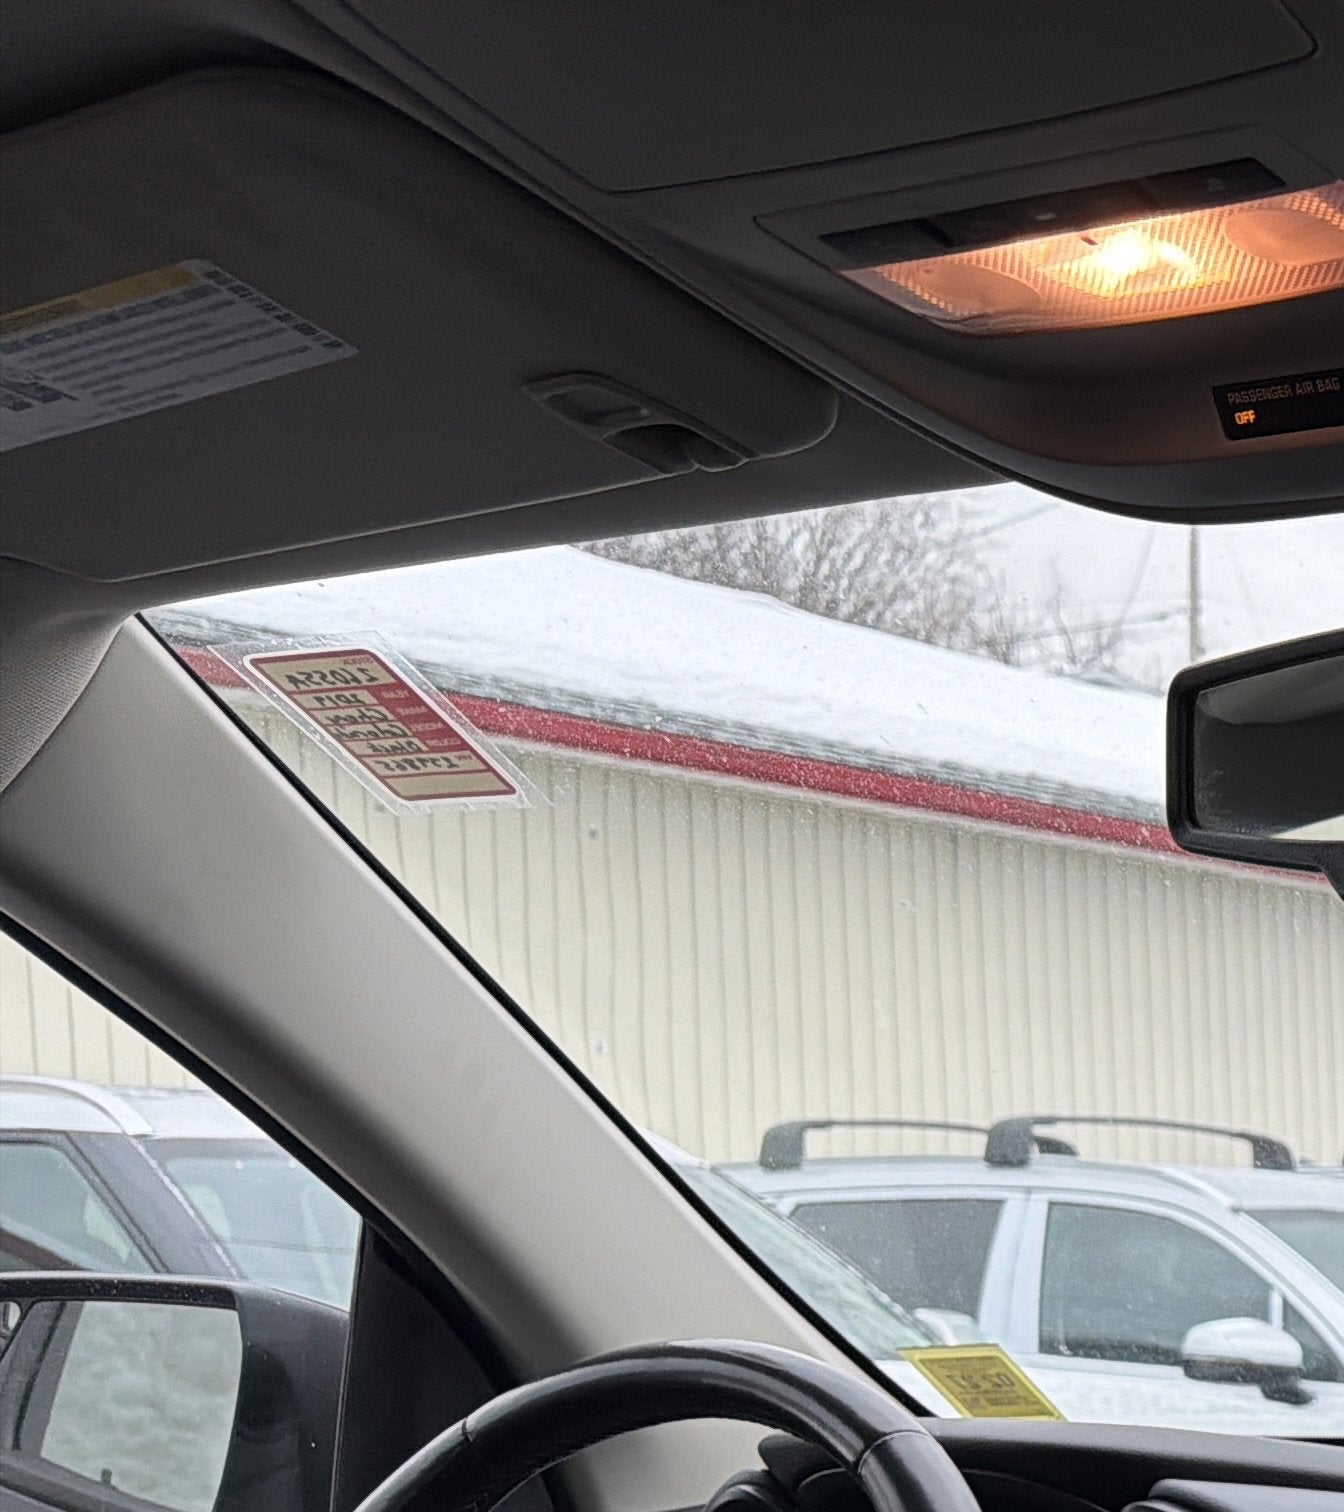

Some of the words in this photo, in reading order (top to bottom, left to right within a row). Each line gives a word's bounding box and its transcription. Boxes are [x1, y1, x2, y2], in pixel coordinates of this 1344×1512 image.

[1227, 385, 1293, 405] PASSENGER
[1296, 381, 1314, 396] AIR
[1317, 377, 1341, 393] BAG
[1233, 410, 1257, 425] OFF
